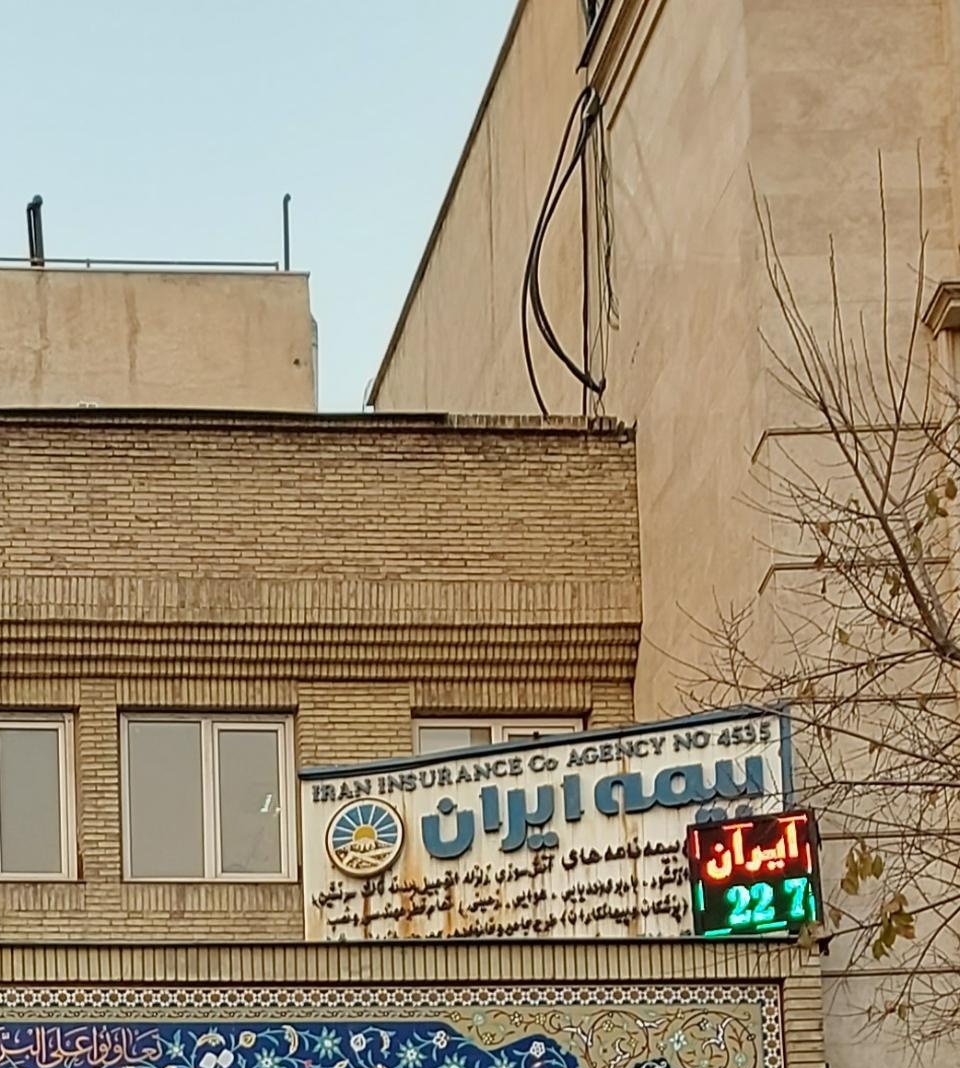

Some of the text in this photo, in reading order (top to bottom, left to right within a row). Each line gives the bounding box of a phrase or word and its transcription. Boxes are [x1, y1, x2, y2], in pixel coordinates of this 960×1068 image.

[312, 779, 373, 803] IRAN
[378, 756, 523, 794] INSURANCE
[566, 736, 666, 768] AGENCY
[717, 722, 772, 747] 4535
[421, 754, 766, 861] بیمه ایران
